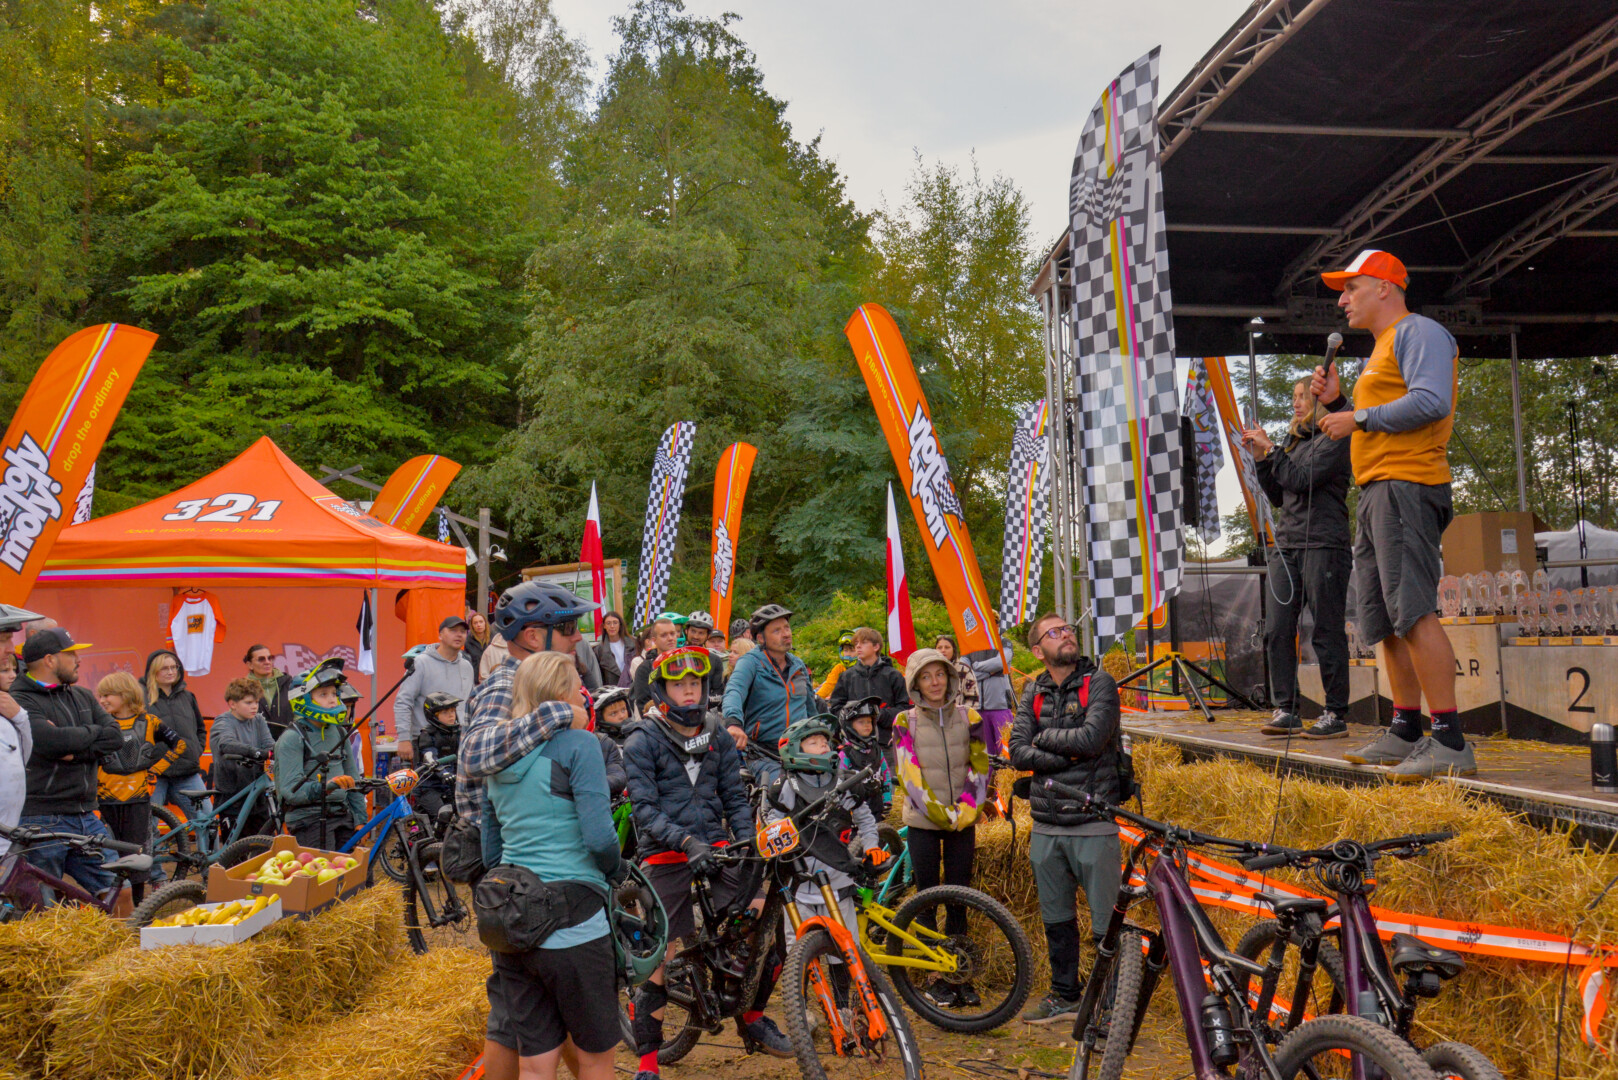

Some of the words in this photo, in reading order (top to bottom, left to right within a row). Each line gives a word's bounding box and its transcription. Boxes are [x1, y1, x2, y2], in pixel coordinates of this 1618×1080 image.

[63, 442, 83, 472] drop
[76, 420, 92, 440] the
[89, 367, 120, 419] ordinary
[161, 492, 283, 523] 321
[414, 482, 436, 514] ordinary
[1565, 666, 1596, 713] 2
[684, 732, 711, 752] LEATT
[766, 831, 793, 856] 193
